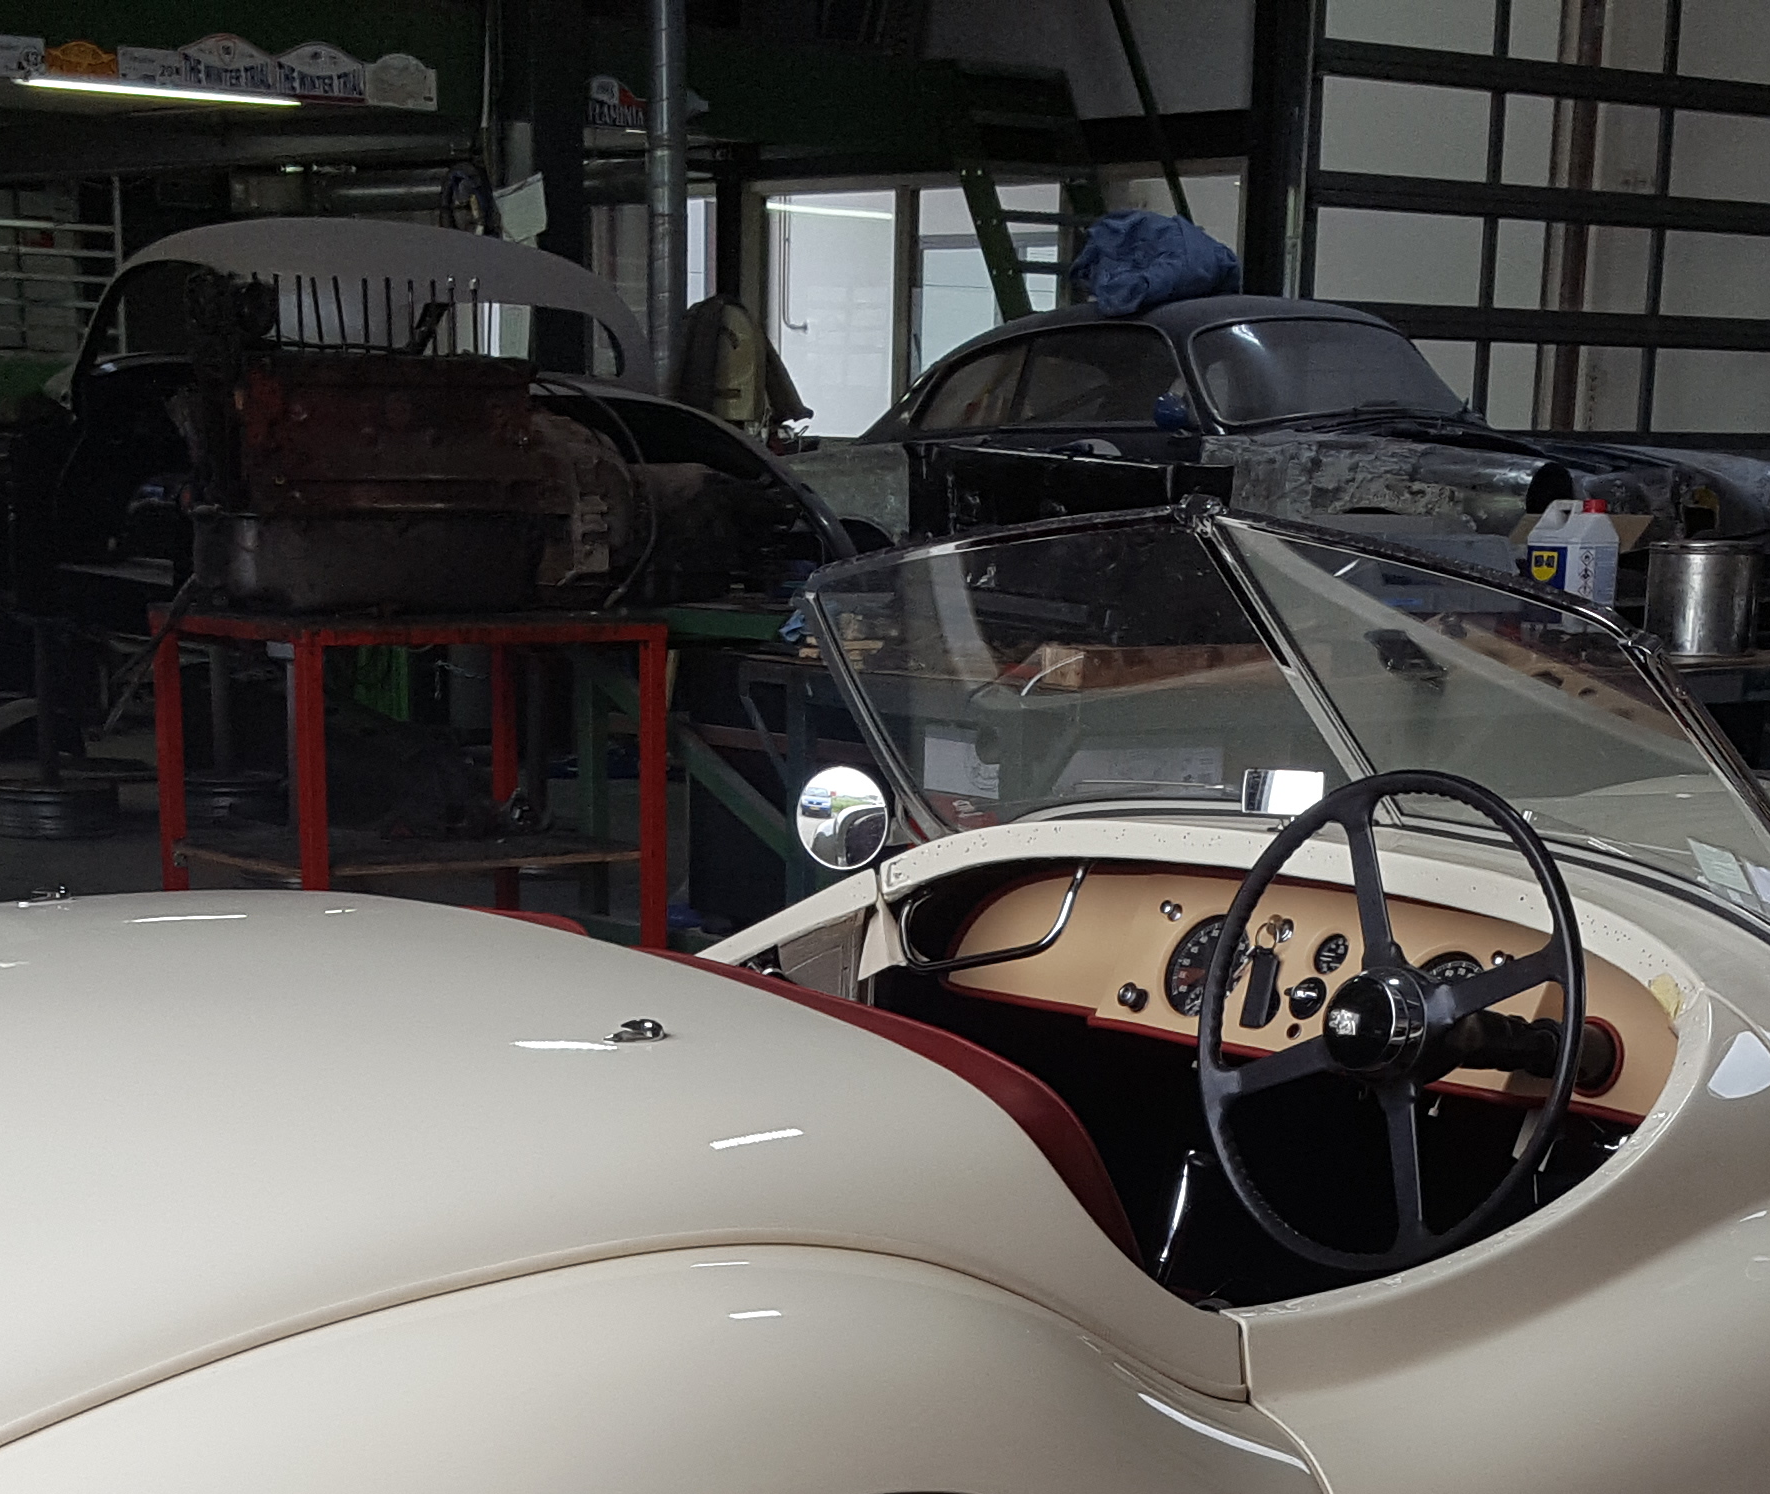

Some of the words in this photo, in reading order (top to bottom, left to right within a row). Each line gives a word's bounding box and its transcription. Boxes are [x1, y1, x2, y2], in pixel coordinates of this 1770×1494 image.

[182, 52, 203, 84] THE
[205, 65, 240, 87] WINTER
[243, 62, 271, 89] TRIAL
[277, 61, 296, 93] THE
[298, 69, 334, 94] WINTER
[336, 67, 364, 96] TRIAL
